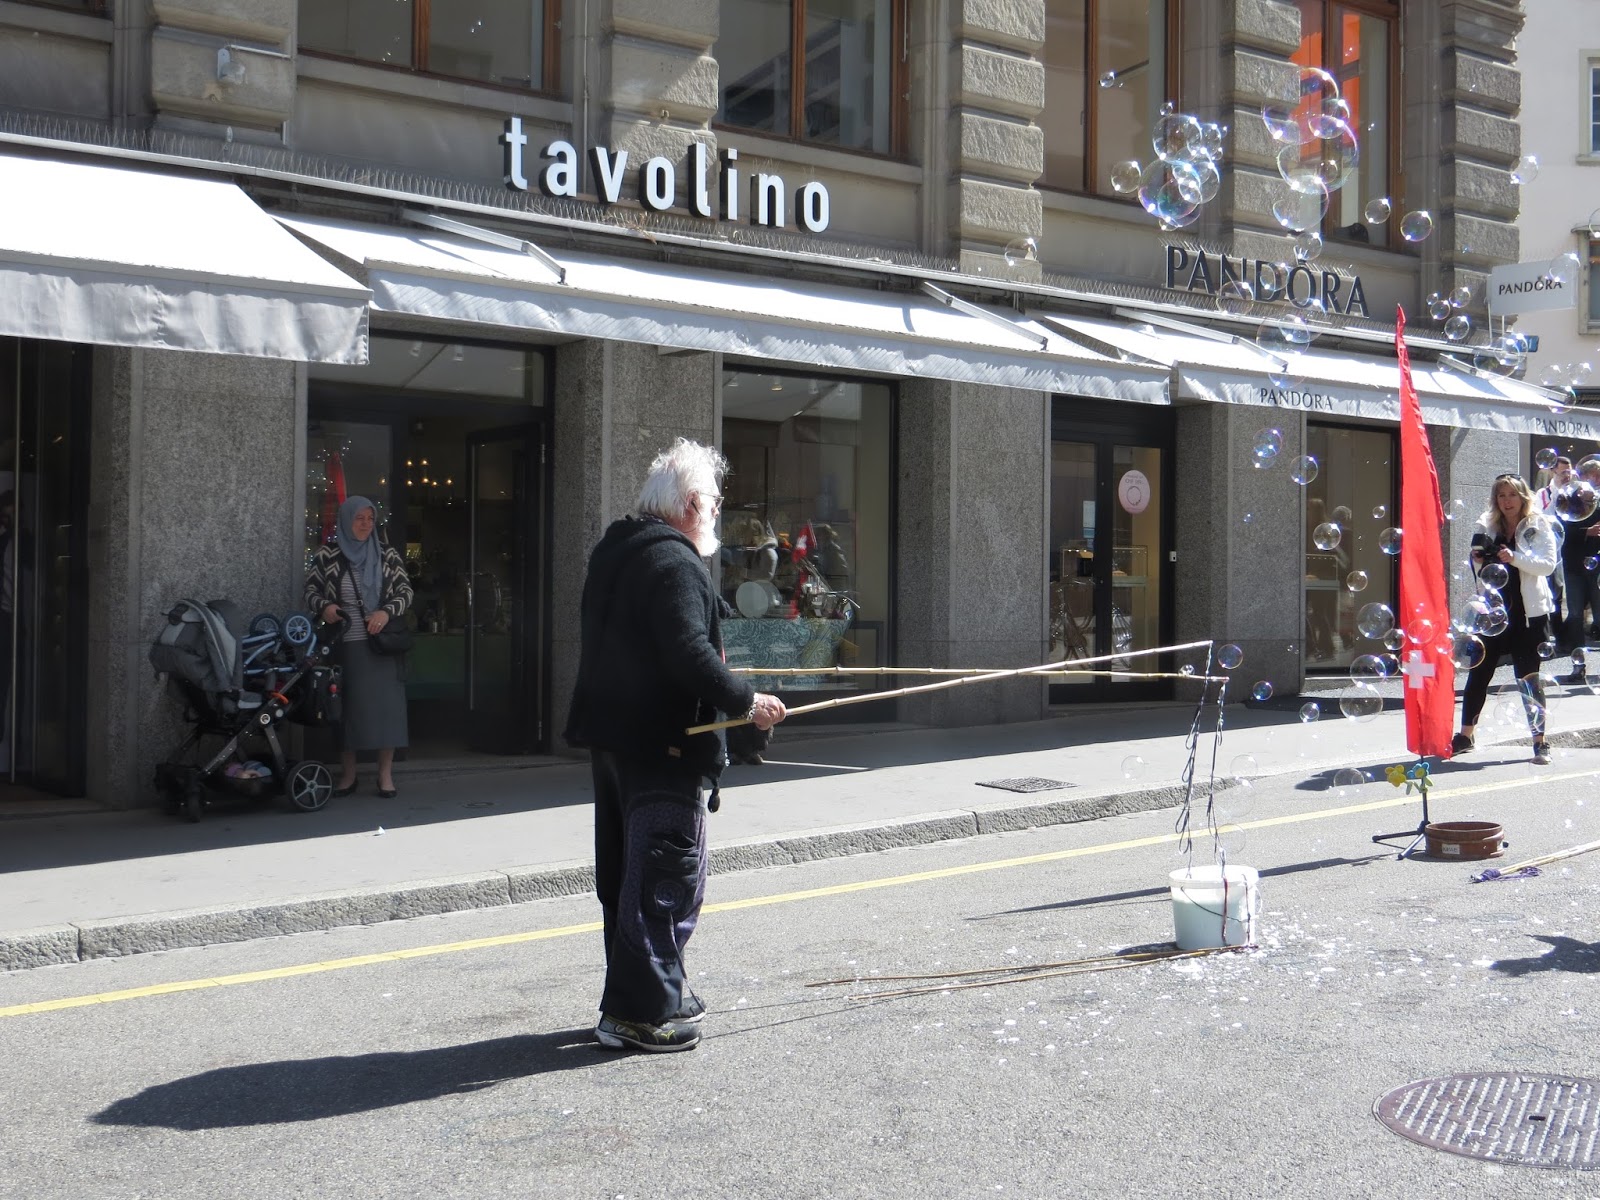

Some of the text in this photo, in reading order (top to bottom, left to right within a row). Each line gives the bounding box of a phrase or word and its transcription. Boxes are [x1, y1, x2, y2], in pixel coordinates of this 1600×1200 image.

[504, 116, 830, 234] tavolino
[1165, 245, 1370, 318] PANDORA
[1498, 276, 1563, 295] PANDORA
[1260, 387, 1333, 411] PANDORA
[1535, 417, 1591, 436] PANDORA
